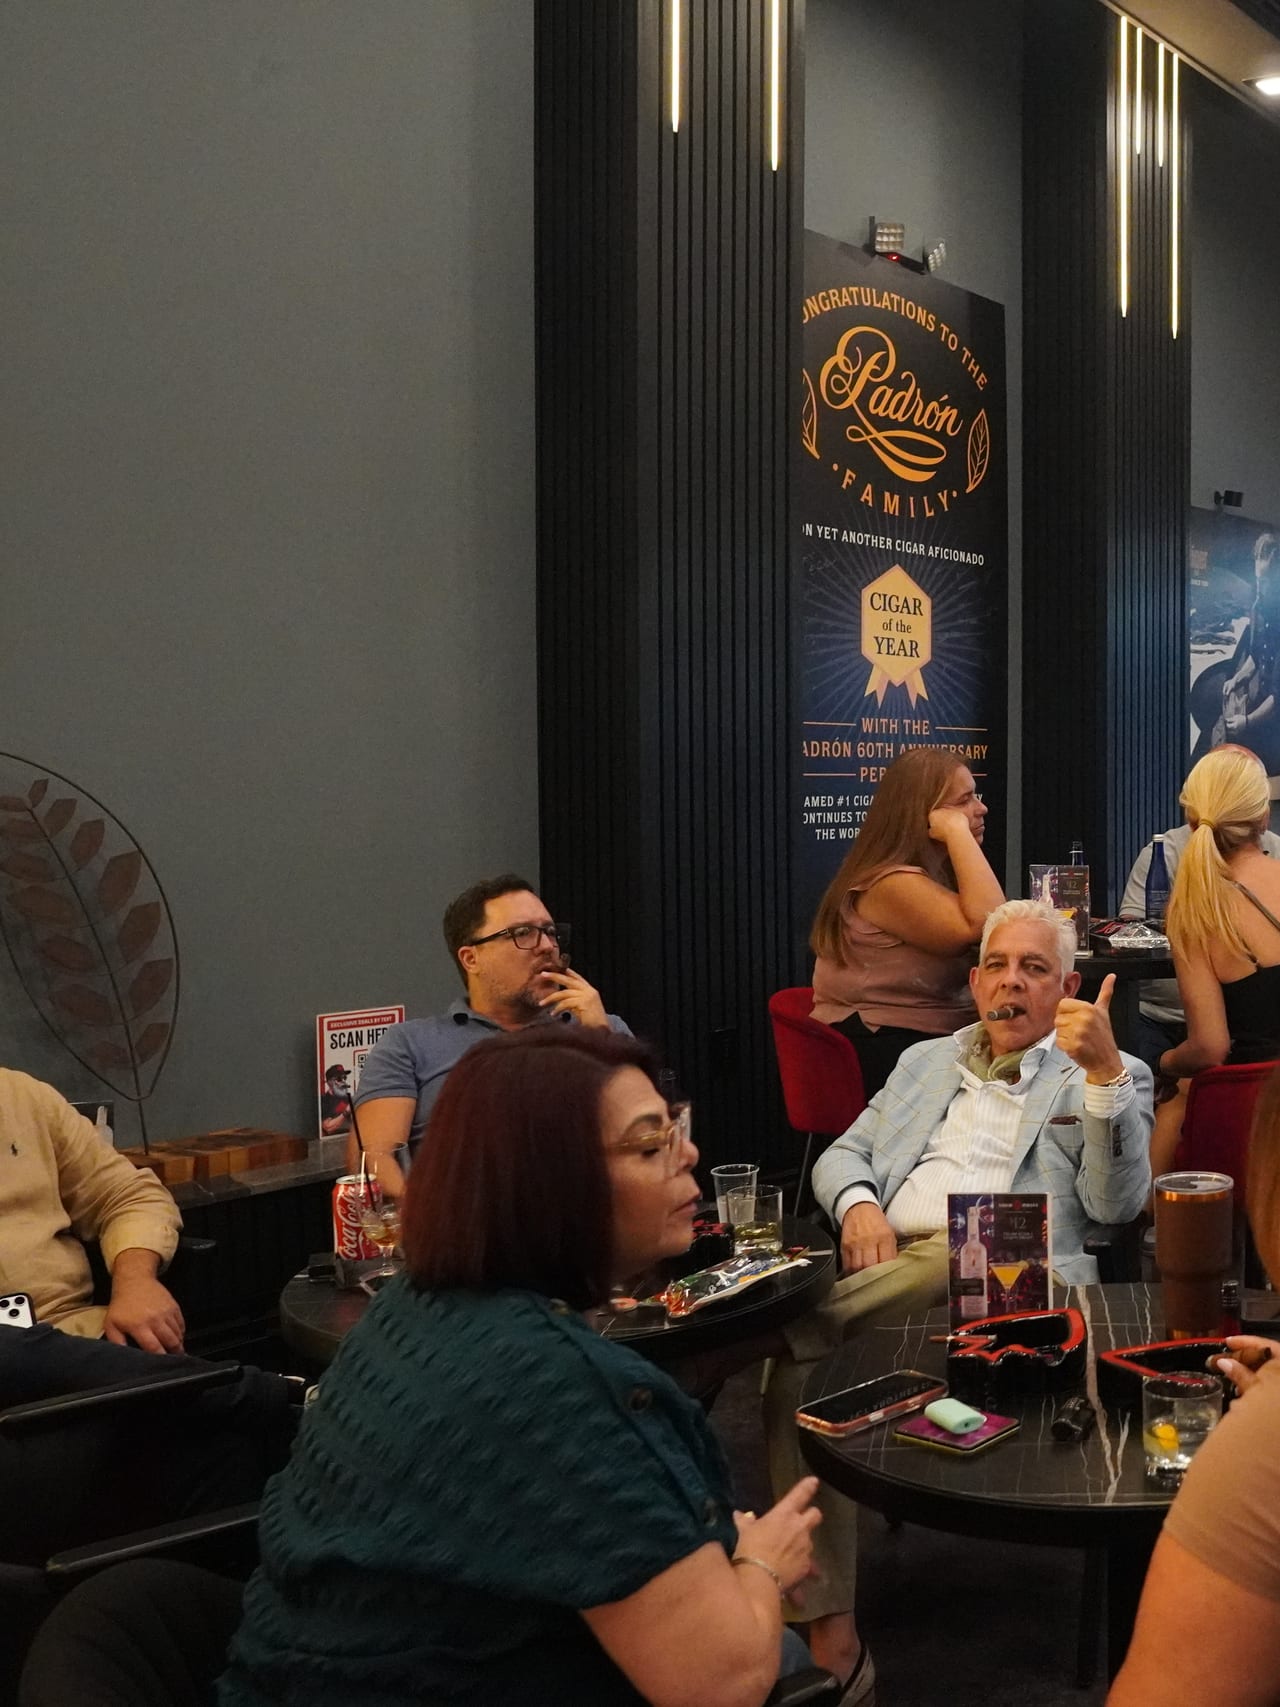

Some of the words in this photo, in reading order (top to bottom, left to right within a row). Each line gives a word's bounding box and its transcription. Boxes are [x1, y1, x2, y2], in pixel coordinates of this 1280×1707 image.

[940, 323, 958, 352] TO
[962, 346, 988, 391] THE
[820, 326, 963, 482] Padrón
[841, 468, 949, 518] FAMILY
[802, 523, 813, 536] N
[816, 525, 838, 541] YET
[841, 530, 893, 550] ANOTHER
[895, 540, 925, 556] CIGAR
[928, 546, 984, 566] AFICIONADO
[870, 592, 923, 616] CIGAR
[882, 618, 893, 632] of
[895, 619, 912, 634] the
[873, 636, 920, 658] YEAR
[862, 717, 898, 734] WITH
[902, 719, 930, 735] THE
[857, 742, 894, 758] 60TH
[804, 796, 834, 808] AMED
[837, 795, 850, 807] #1
[815, 828, 836, 840] THE
[330, 1029, 363, 1050] SCAN
